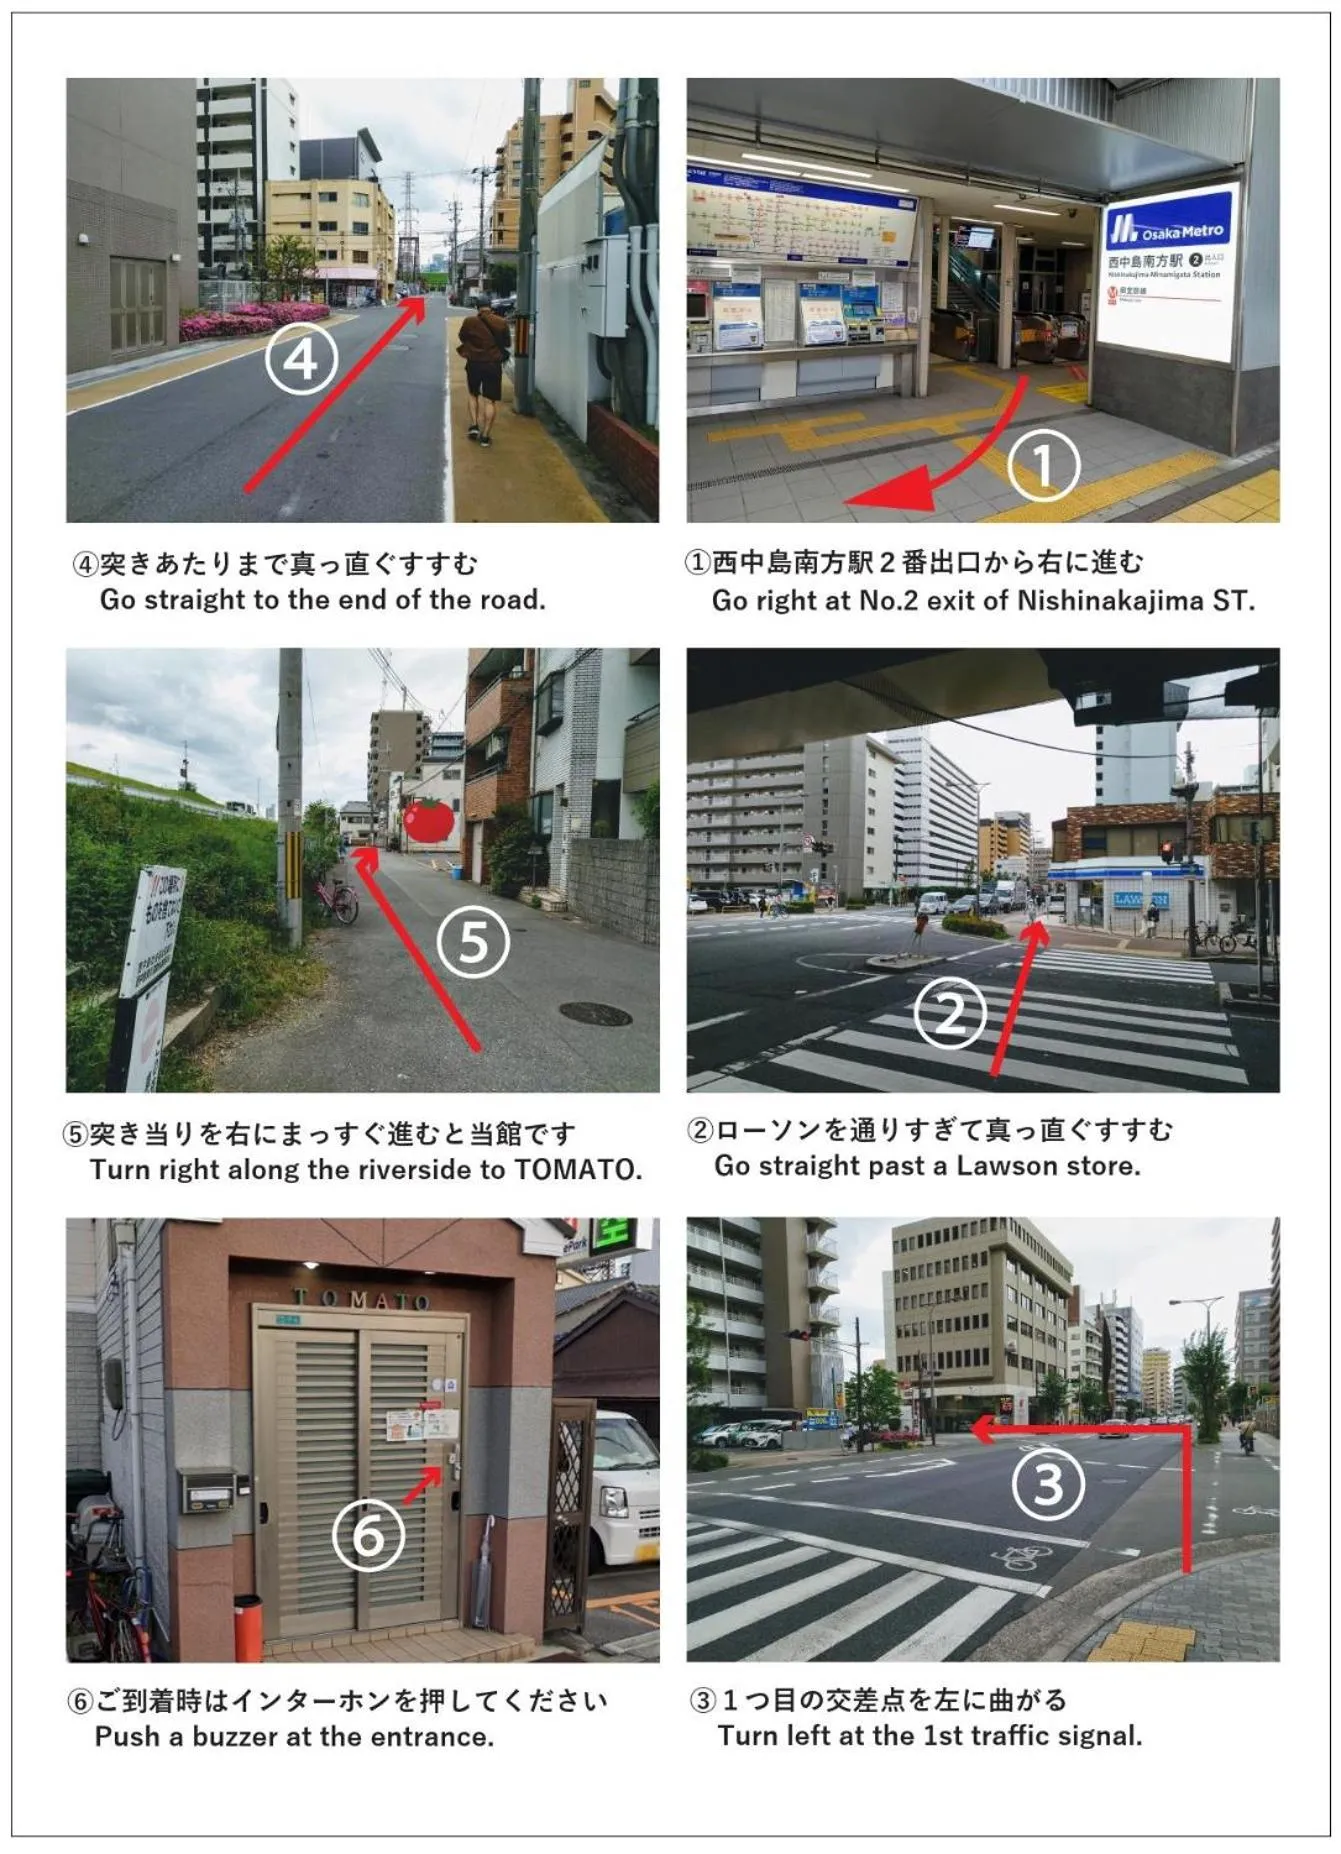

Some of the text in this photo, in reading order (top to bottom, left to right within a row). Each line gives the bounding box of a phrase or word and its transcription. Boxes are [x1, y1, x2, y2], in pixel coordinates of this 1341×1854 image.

[1143, 225, 1224, 241] Osaka Metro
[1108, 253, 1184, 269] 西中島南方駅
[1193, 270, 1221, 279] Station
[1116, 894, 1167, 905] LAWON
[563, 1237, 587, 1253] ePark
[294, 1287, 430, 1312] TOMATO
